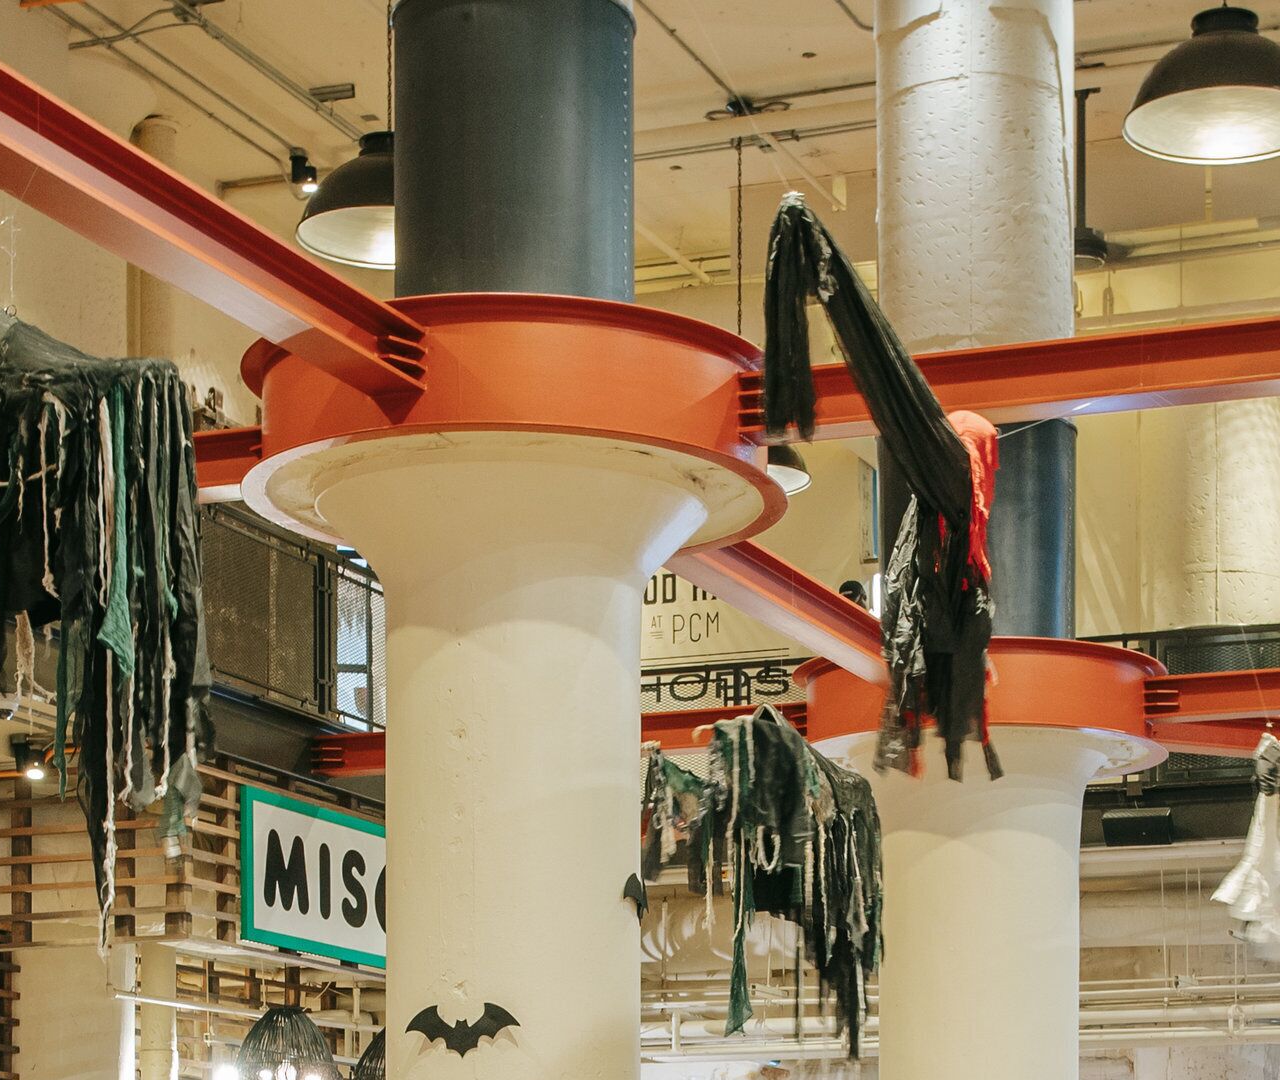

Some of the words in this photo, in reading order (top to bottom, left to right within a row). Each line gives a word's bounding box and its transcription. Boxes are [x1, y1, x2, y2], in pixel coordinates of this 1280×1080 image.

[650, 615, 663, 629] AT
[672, 611, 720, 645] PCM
[263, 828, 386, 935] MIS
